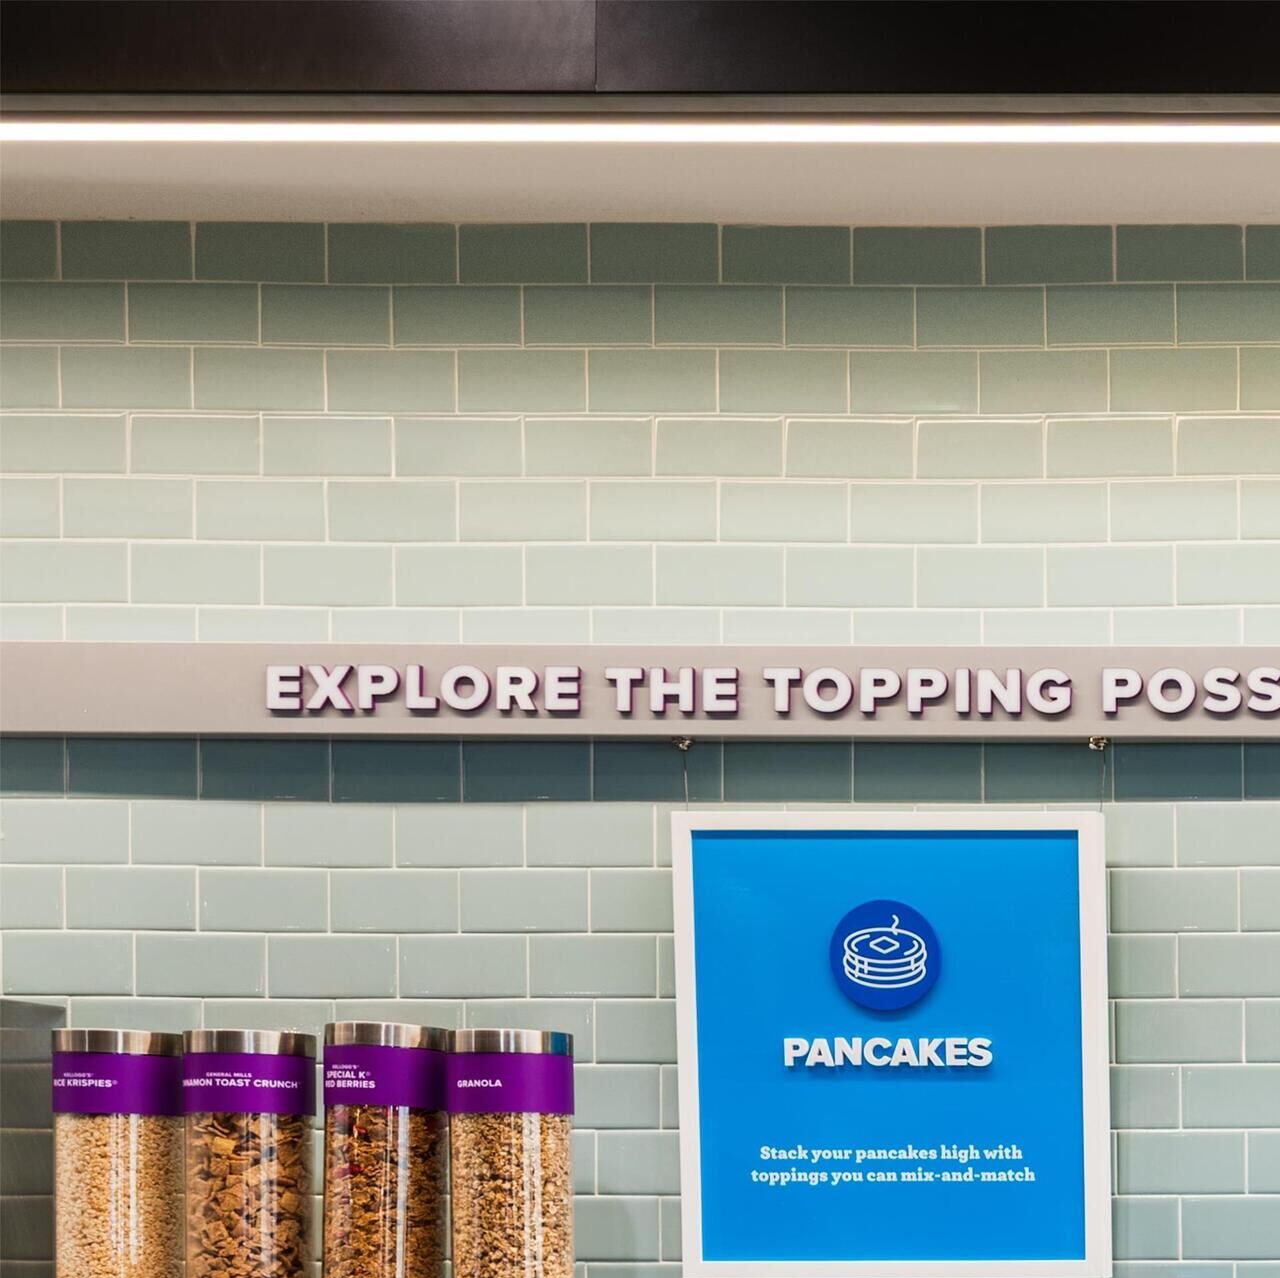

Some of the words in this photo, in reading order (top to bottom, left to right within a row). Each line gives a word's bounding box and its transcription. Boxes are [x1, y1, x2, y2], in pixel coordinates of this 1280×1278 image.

[266, 664, 582, 713] EXPLORE
[605, 666, 740, 713] THE
[763, 666, 1073, 714] TOPPING
[783, 1037, 993, 1067] PANCAKES
[253, 1079, 298, 1088] CRUNCH
[337, 1080, 376, 1088] BERRIES
[457, 1079, 502, 1087] GRANOLA
[759, 1145, 809, 1160] Stack
[811, 1148, 852, 1163] your
[855, 1145, 938, 1163] pancakes
[940, 1144, 981, 1163] high
[983, 1144, 1023, 1160] with
[751, 1167, 828, 1185] toppings
[831, 1170, 863, 1185] you
[866, 1170, 898, 1182] can
[900, 1167, 1036, 1182] mix-and-match
